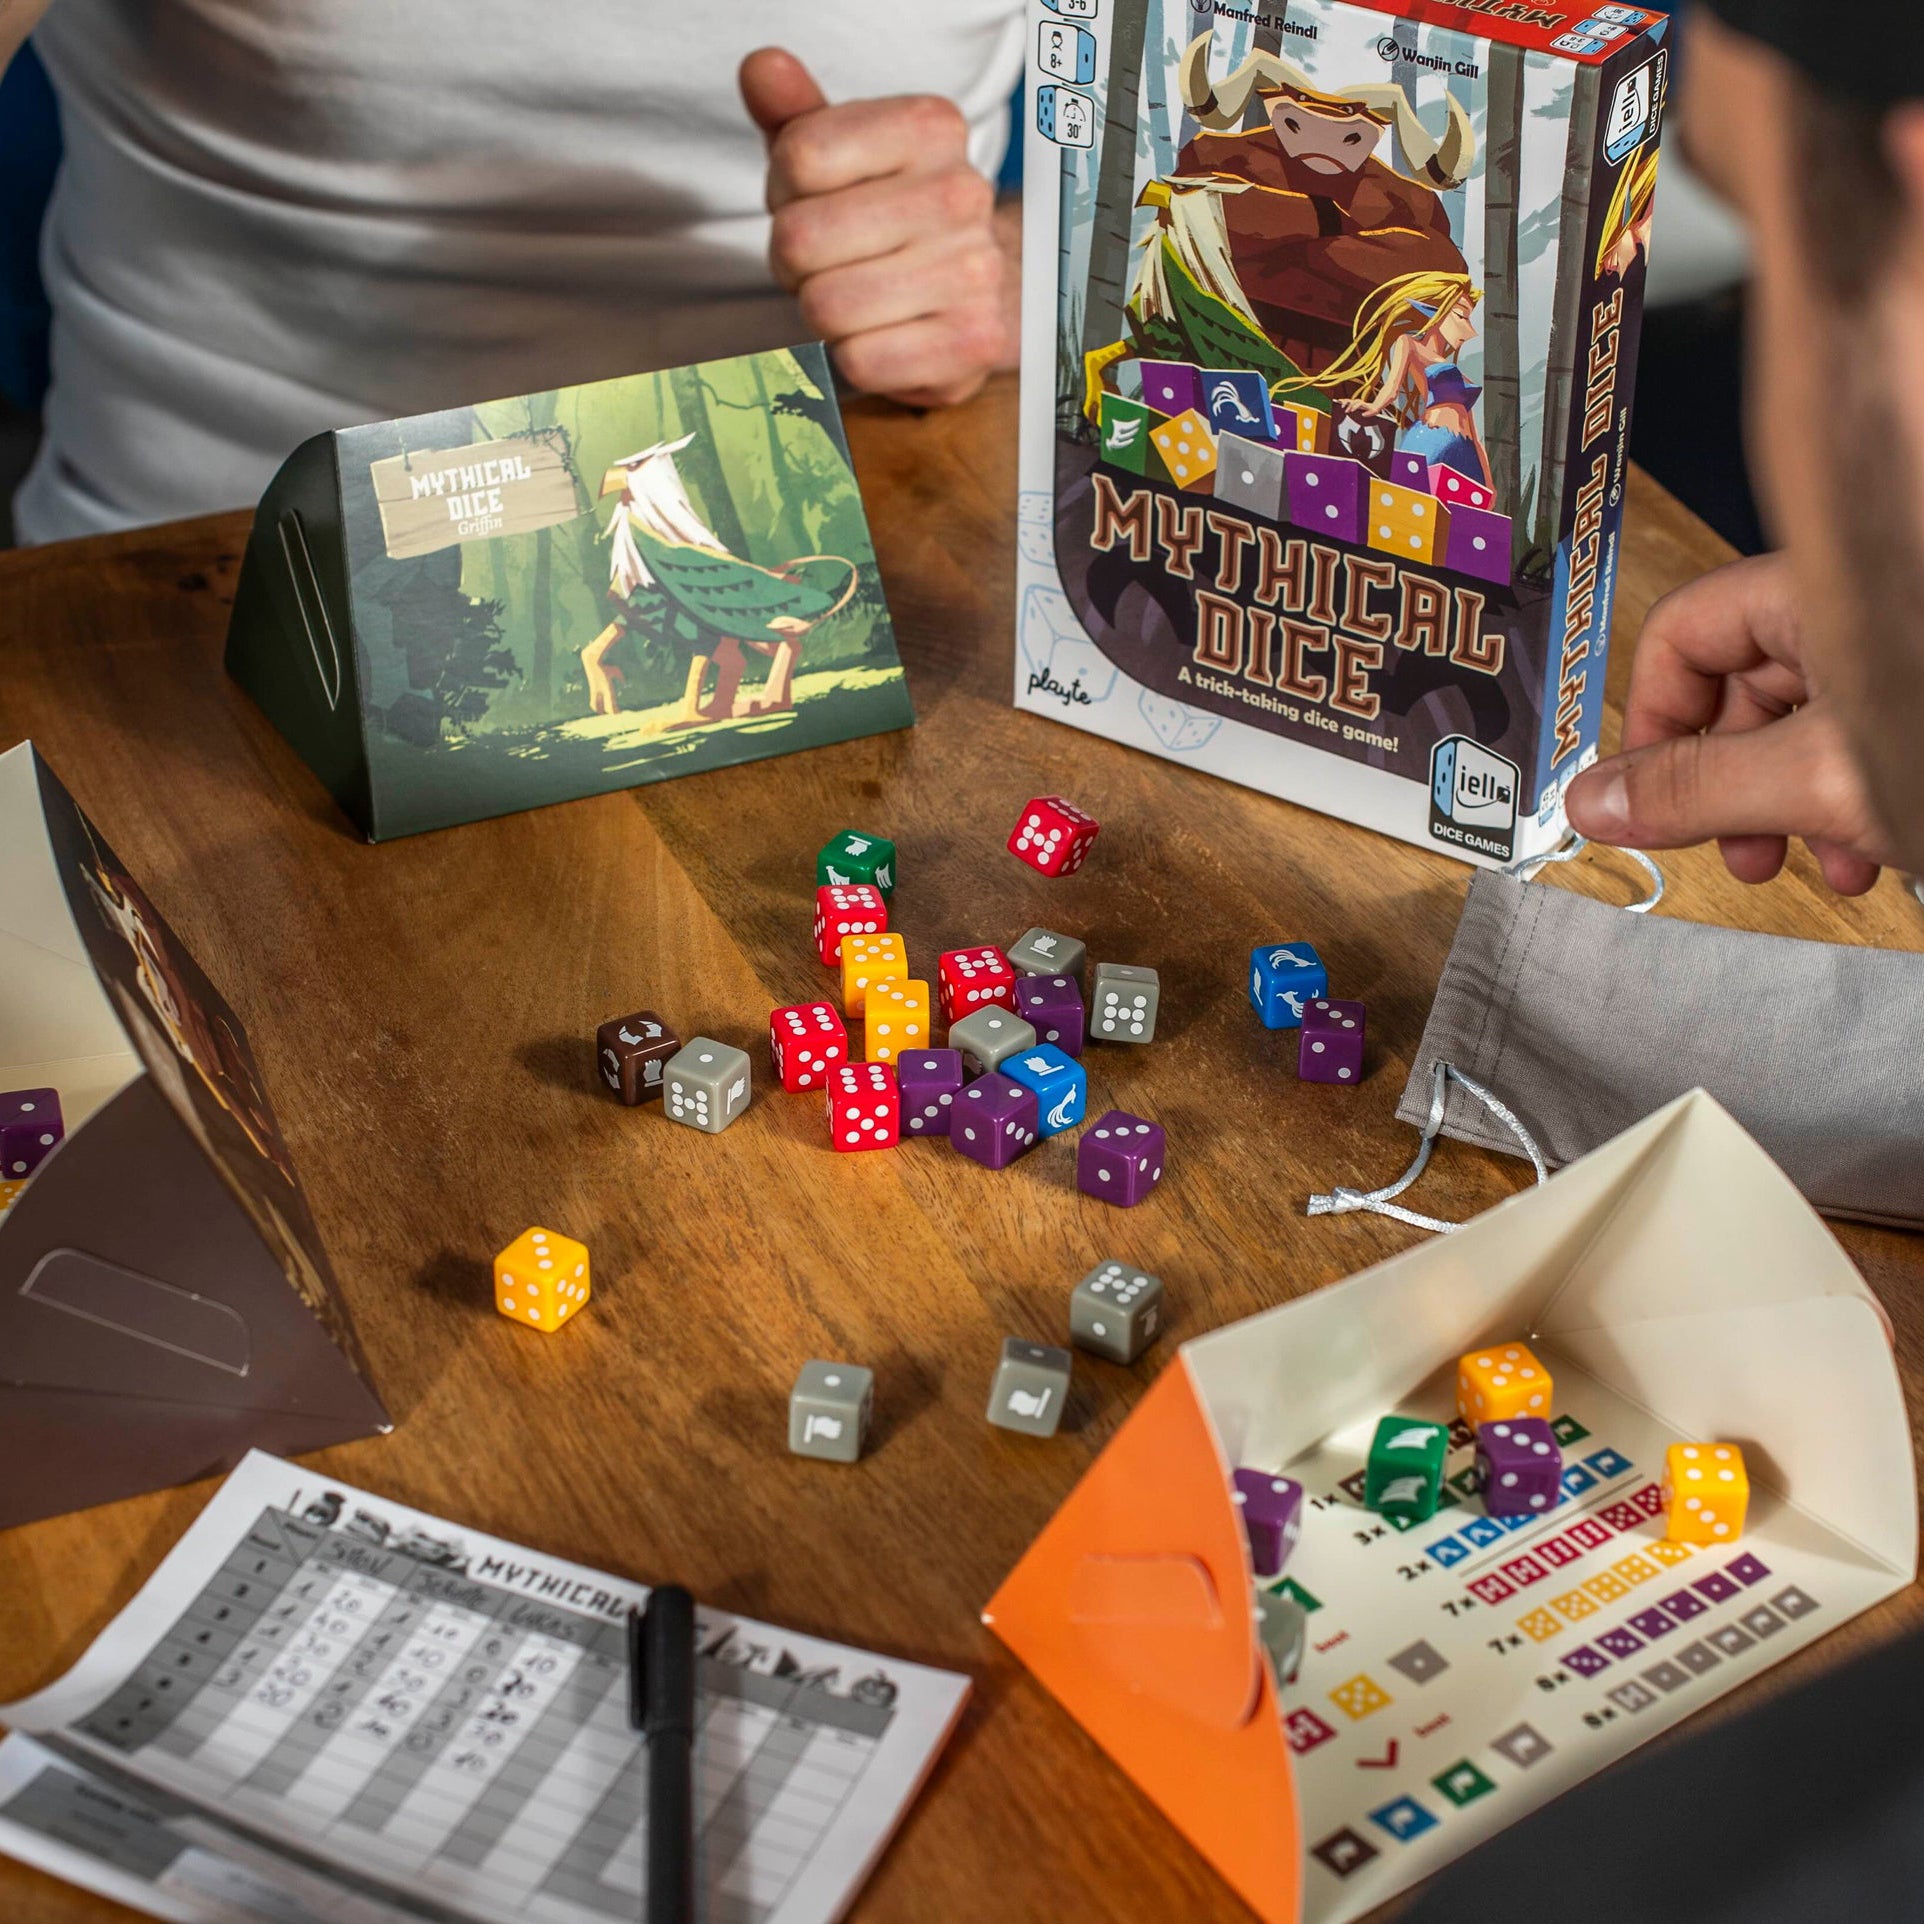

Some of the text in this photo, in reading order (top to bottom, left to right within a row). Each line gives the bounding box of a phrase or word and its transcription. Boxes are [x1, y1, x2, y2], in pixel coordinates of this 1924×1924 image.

[1213, 4, 1318, 40] Manfred Reindl
[1050, 53, 1063, 69] 8+
[1401, 47, 1480, 80] Wanjin Gill
[1649, 55, 1664, 134] DICE GAMES
[408, 455, 532, 500] MYTHICAL
[446, 487, 504, 521] DICE
[457, 514, 504, 536] Griffin
[1551, 286, 1624, 771] MYTHICAL DICE
[1090, 472, 1505, 677] MYTHICAL
[1193, 589, 1385, 721] DICE
[1027, 666, 1093, 707] playte
[1177, 666, 1400, 753] A trick-taking dice game!
[1433, 822, 1511, 858] DICE GAMES
[477, 1555, 626, 1618] MYTHICAL
